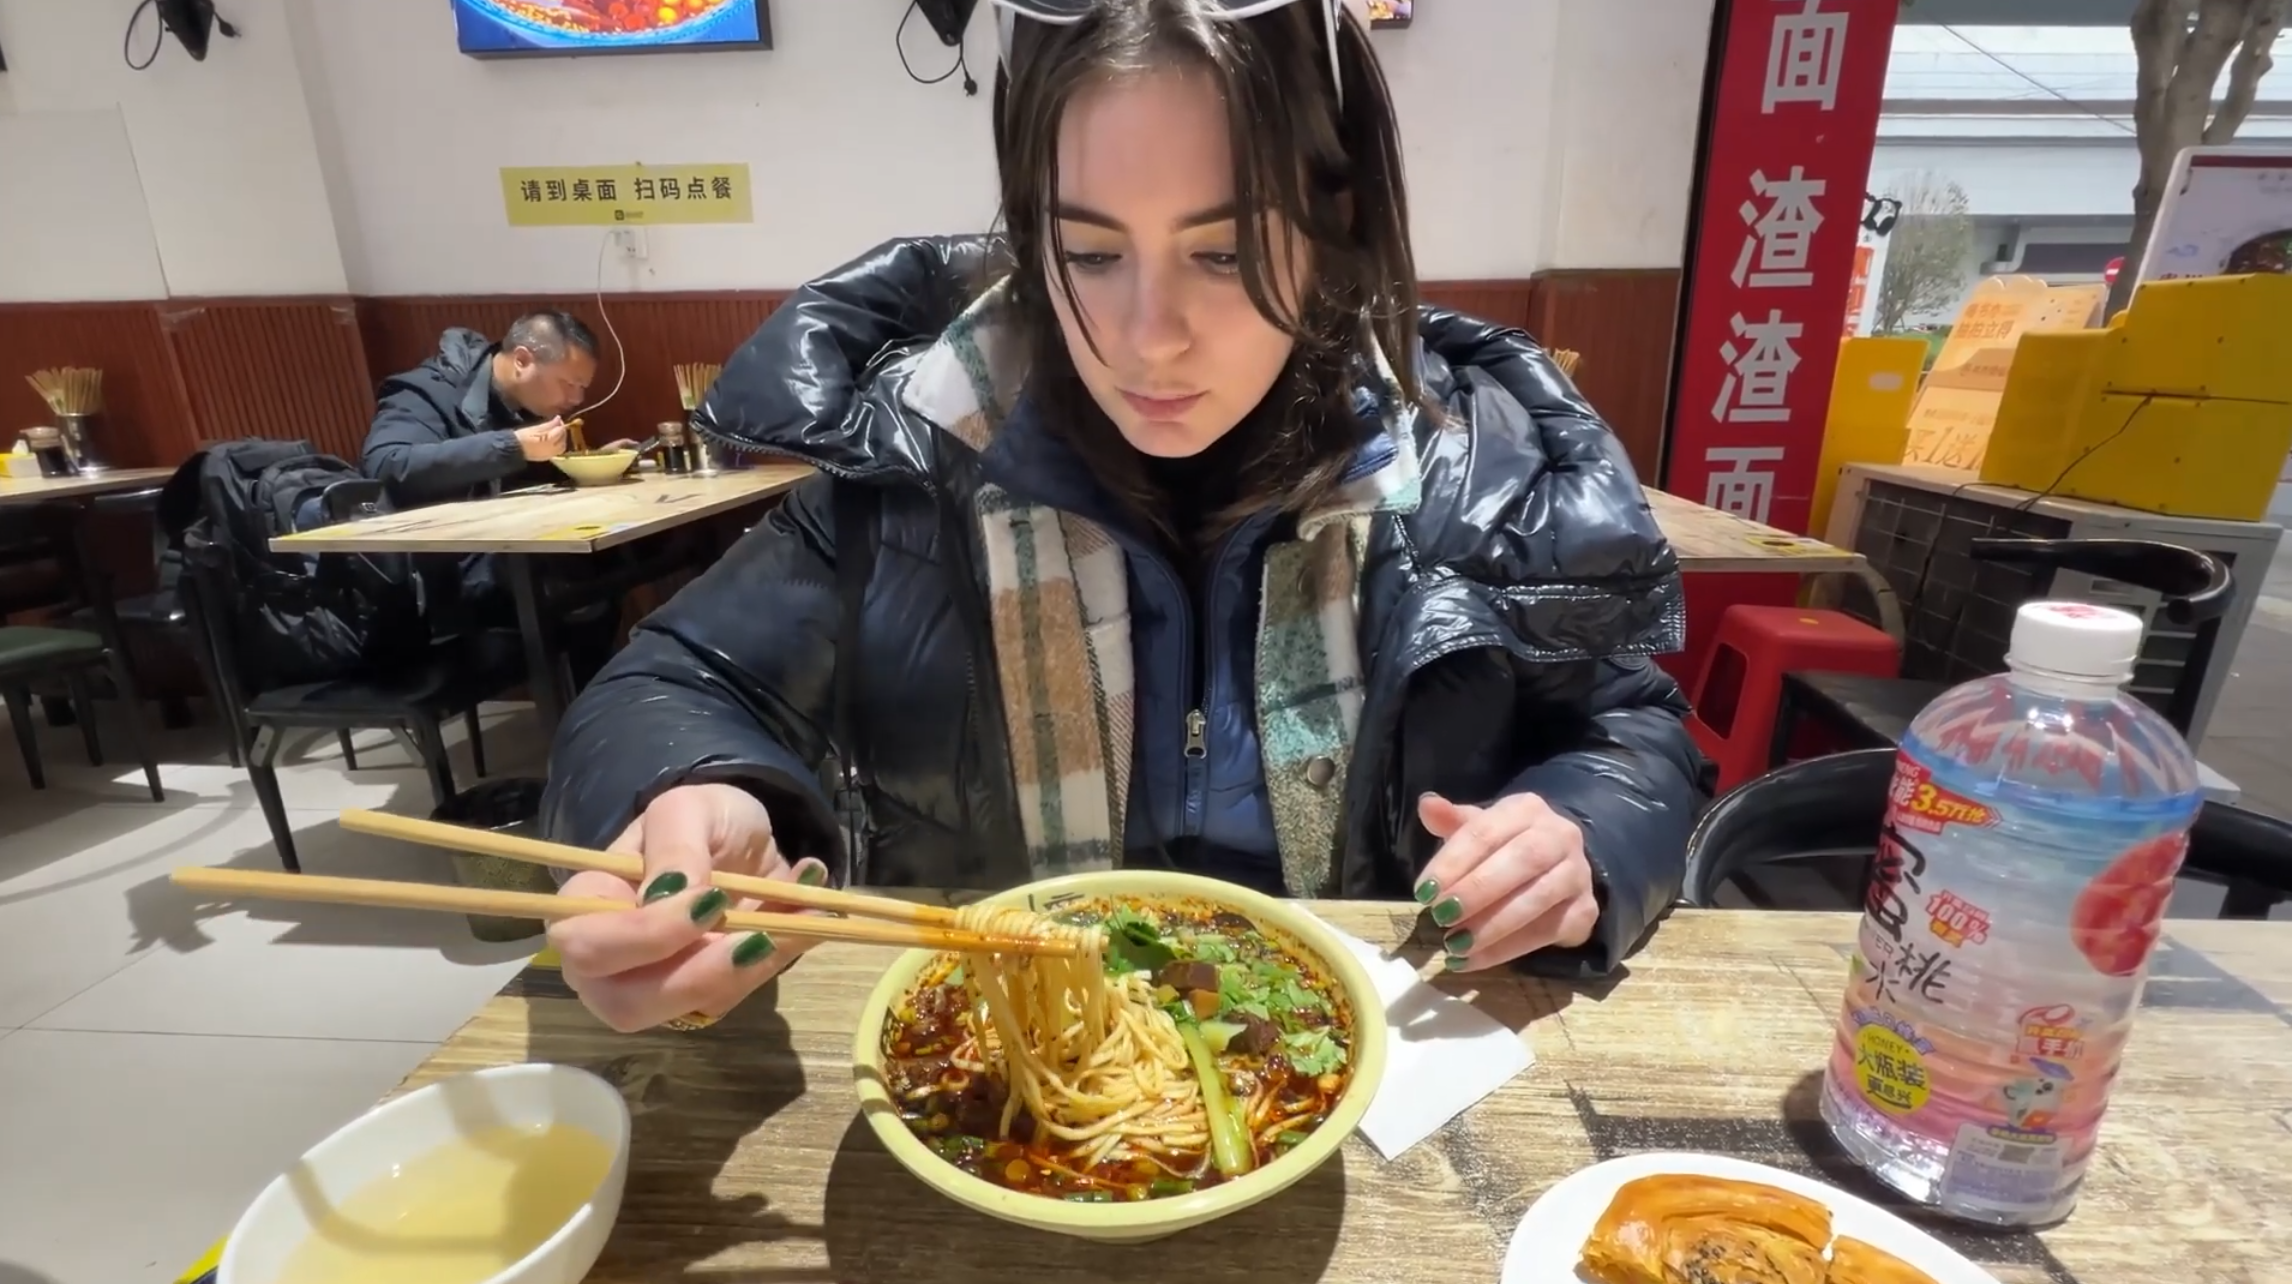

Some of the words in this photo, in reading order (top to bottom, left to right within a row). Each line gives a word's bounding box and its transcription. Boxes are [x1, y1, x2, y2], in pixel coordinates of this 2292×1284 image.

[1761, 0, 1849, 114] 面
[521, 179, 617, 202] 请到桌面
[634, 176, 732, 200] 扫码点餐
[1705, 165, 1826, 529] 渣渣面
[1926, 895, 1989, 944] 100%
[1858, 1044, 1927, 1090] 大瓶装
